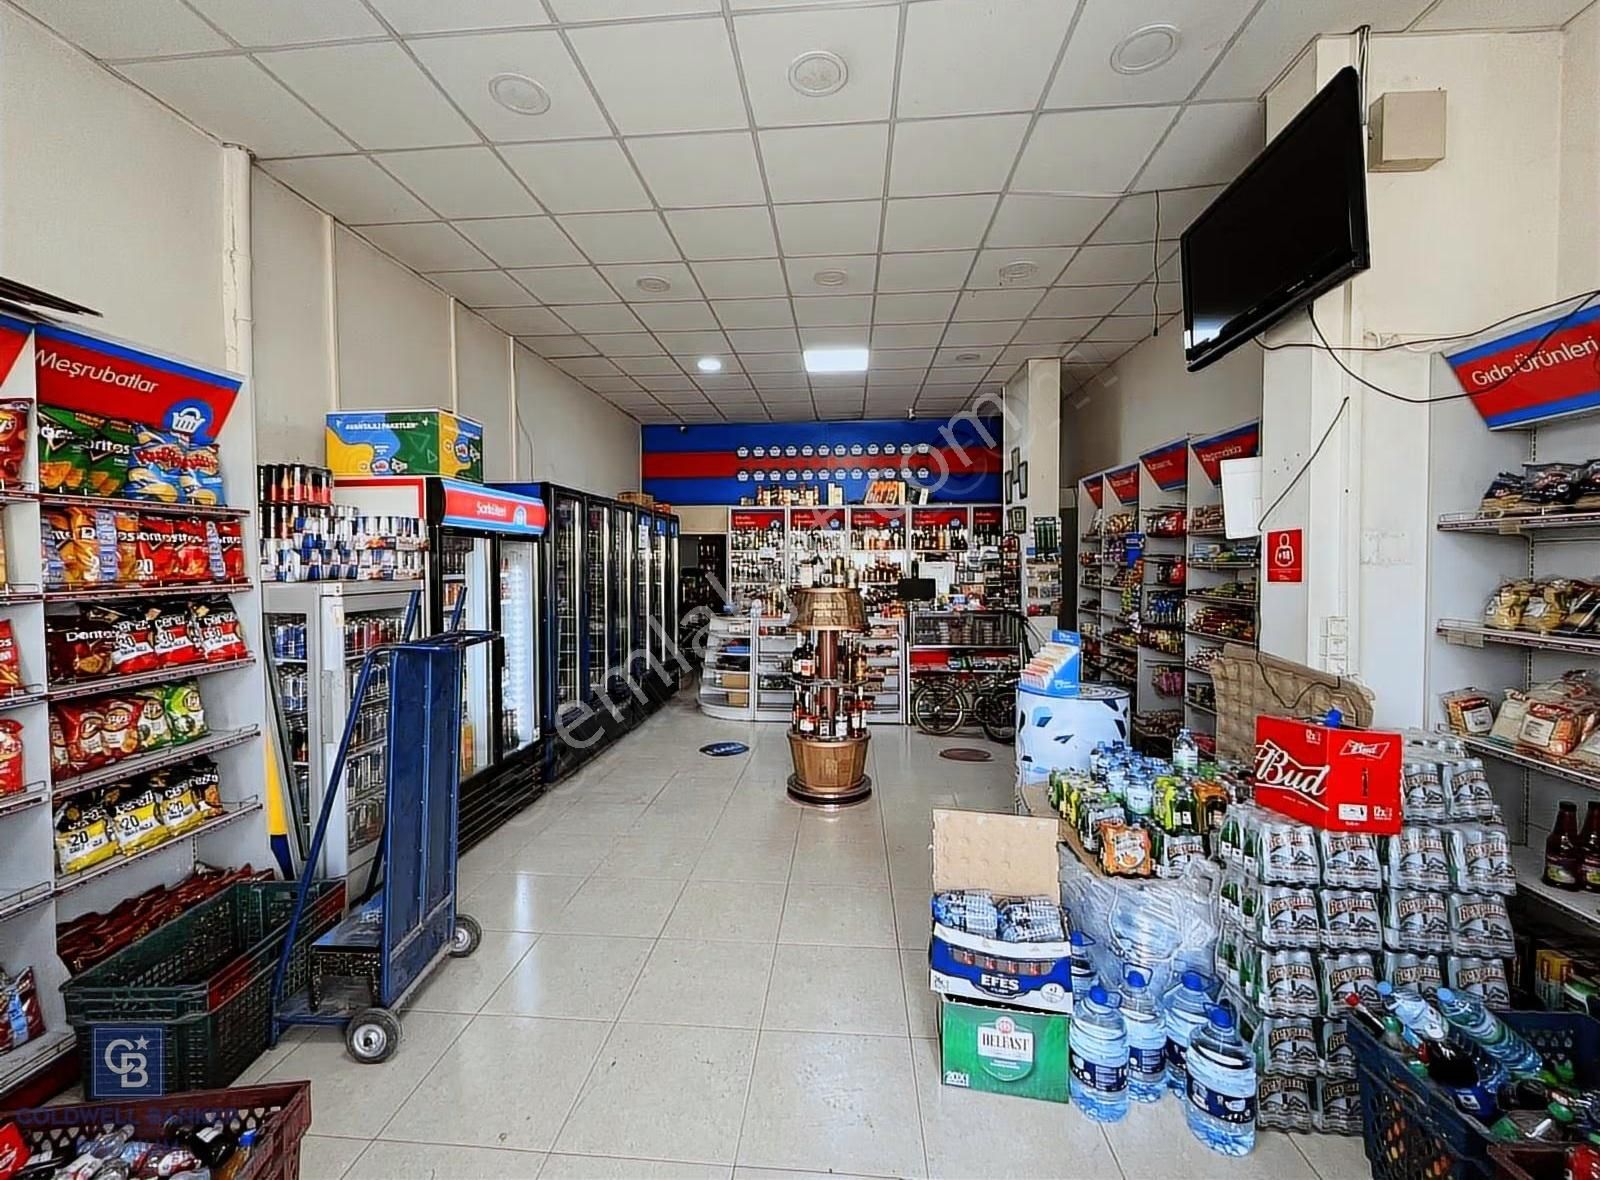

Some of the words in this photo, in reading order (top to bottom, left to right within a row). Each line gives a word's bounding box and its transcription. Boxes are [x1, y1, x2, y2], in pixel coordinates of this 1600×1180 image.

[1515, 335, 1599, 373] Ürünleri
[36, 348, 160, 395] Meşrubatlar
[1256, 739, 1330, 796] Bud
[70, 830, 89, 847] 20
[981, 974, 1020, 991] EFES
[981, 1032, 1030, 1052] BELFAST
